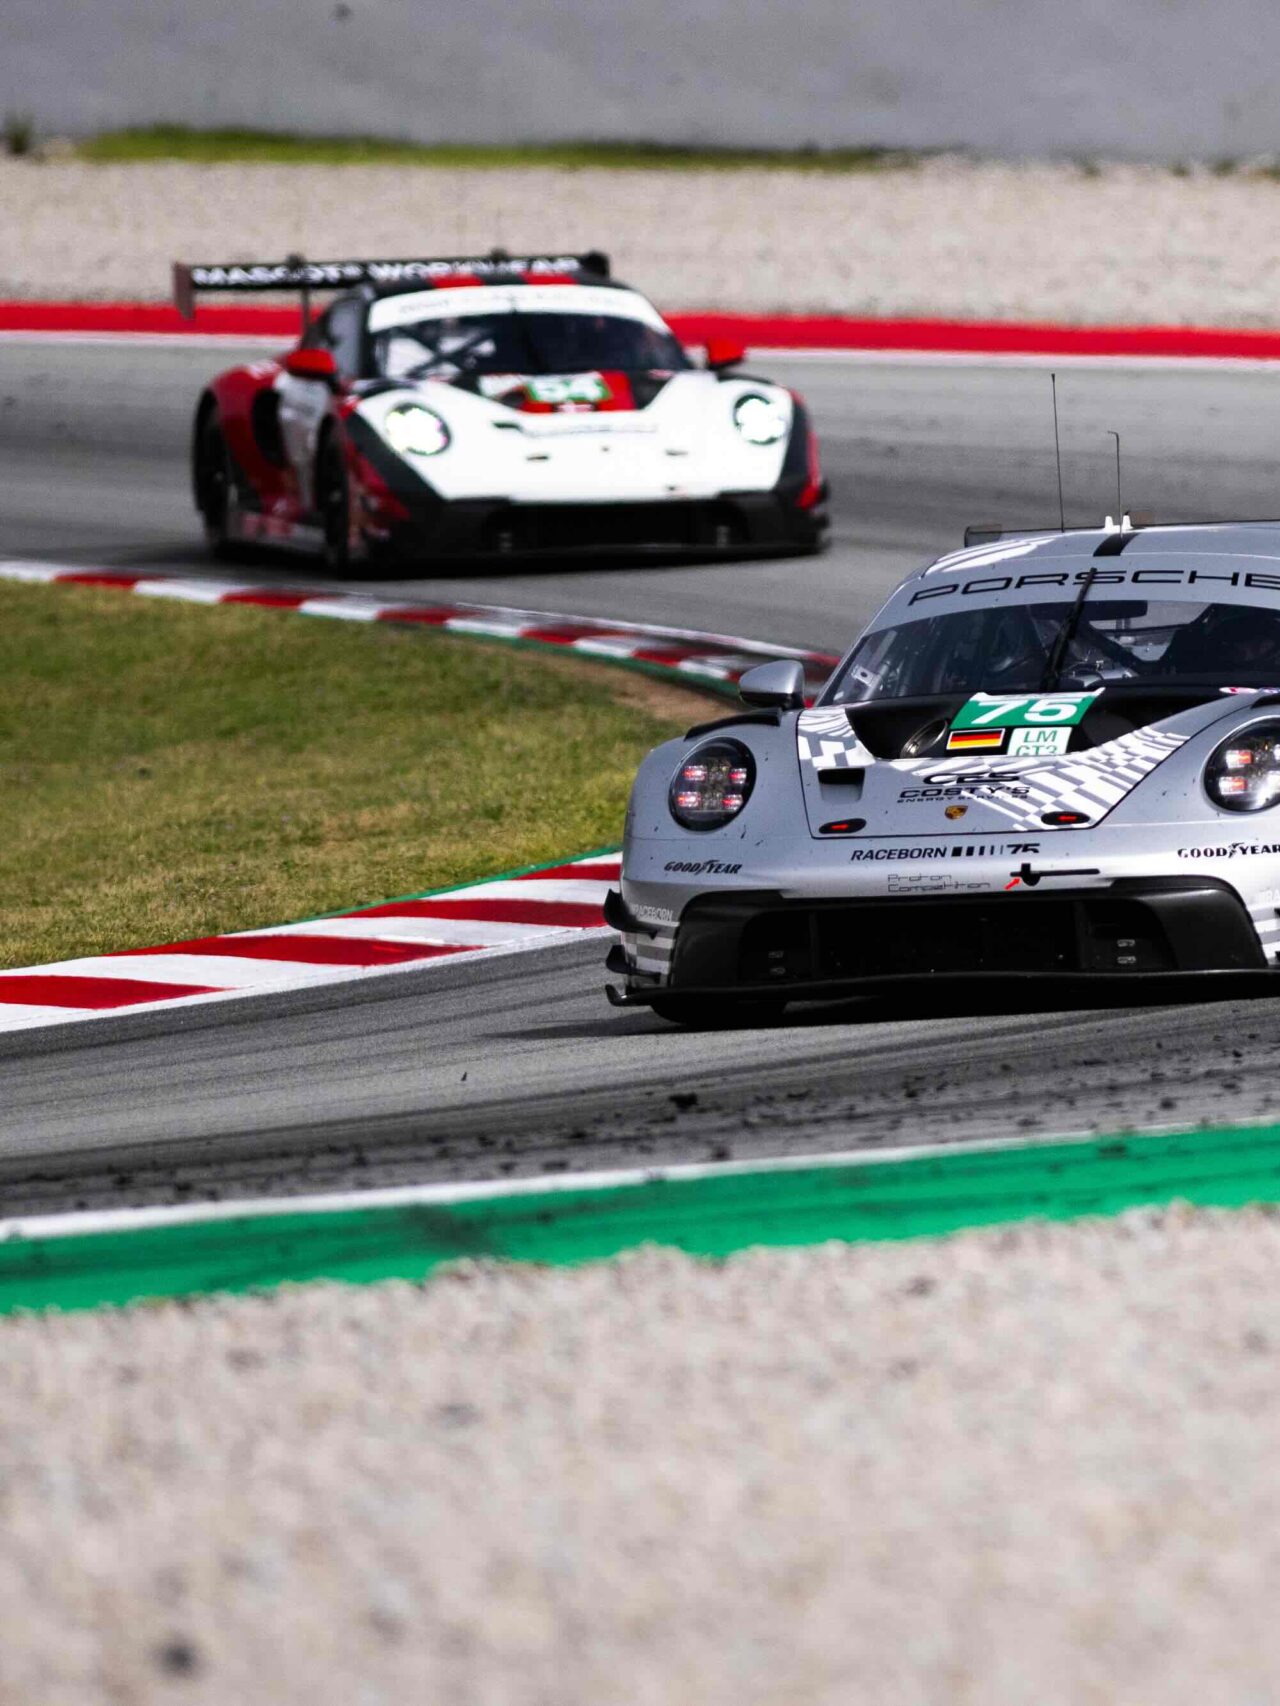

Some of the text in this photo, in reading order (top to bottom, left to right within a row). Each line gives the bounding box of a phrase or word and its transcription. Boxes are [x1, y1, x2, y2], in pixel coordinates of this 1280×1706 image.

[970, 698, 1083, 725] 75
[1023, 730, 1058, 743] LM
[900, 786, 1030, 799] COSTY'S
[850, 843, 1041, 861] RACEBORN 75
[664, 860, 743, 875] GOODYEAR
[887, 873, 952, 883] Proton
[887, 881, 991, 894] Competition
